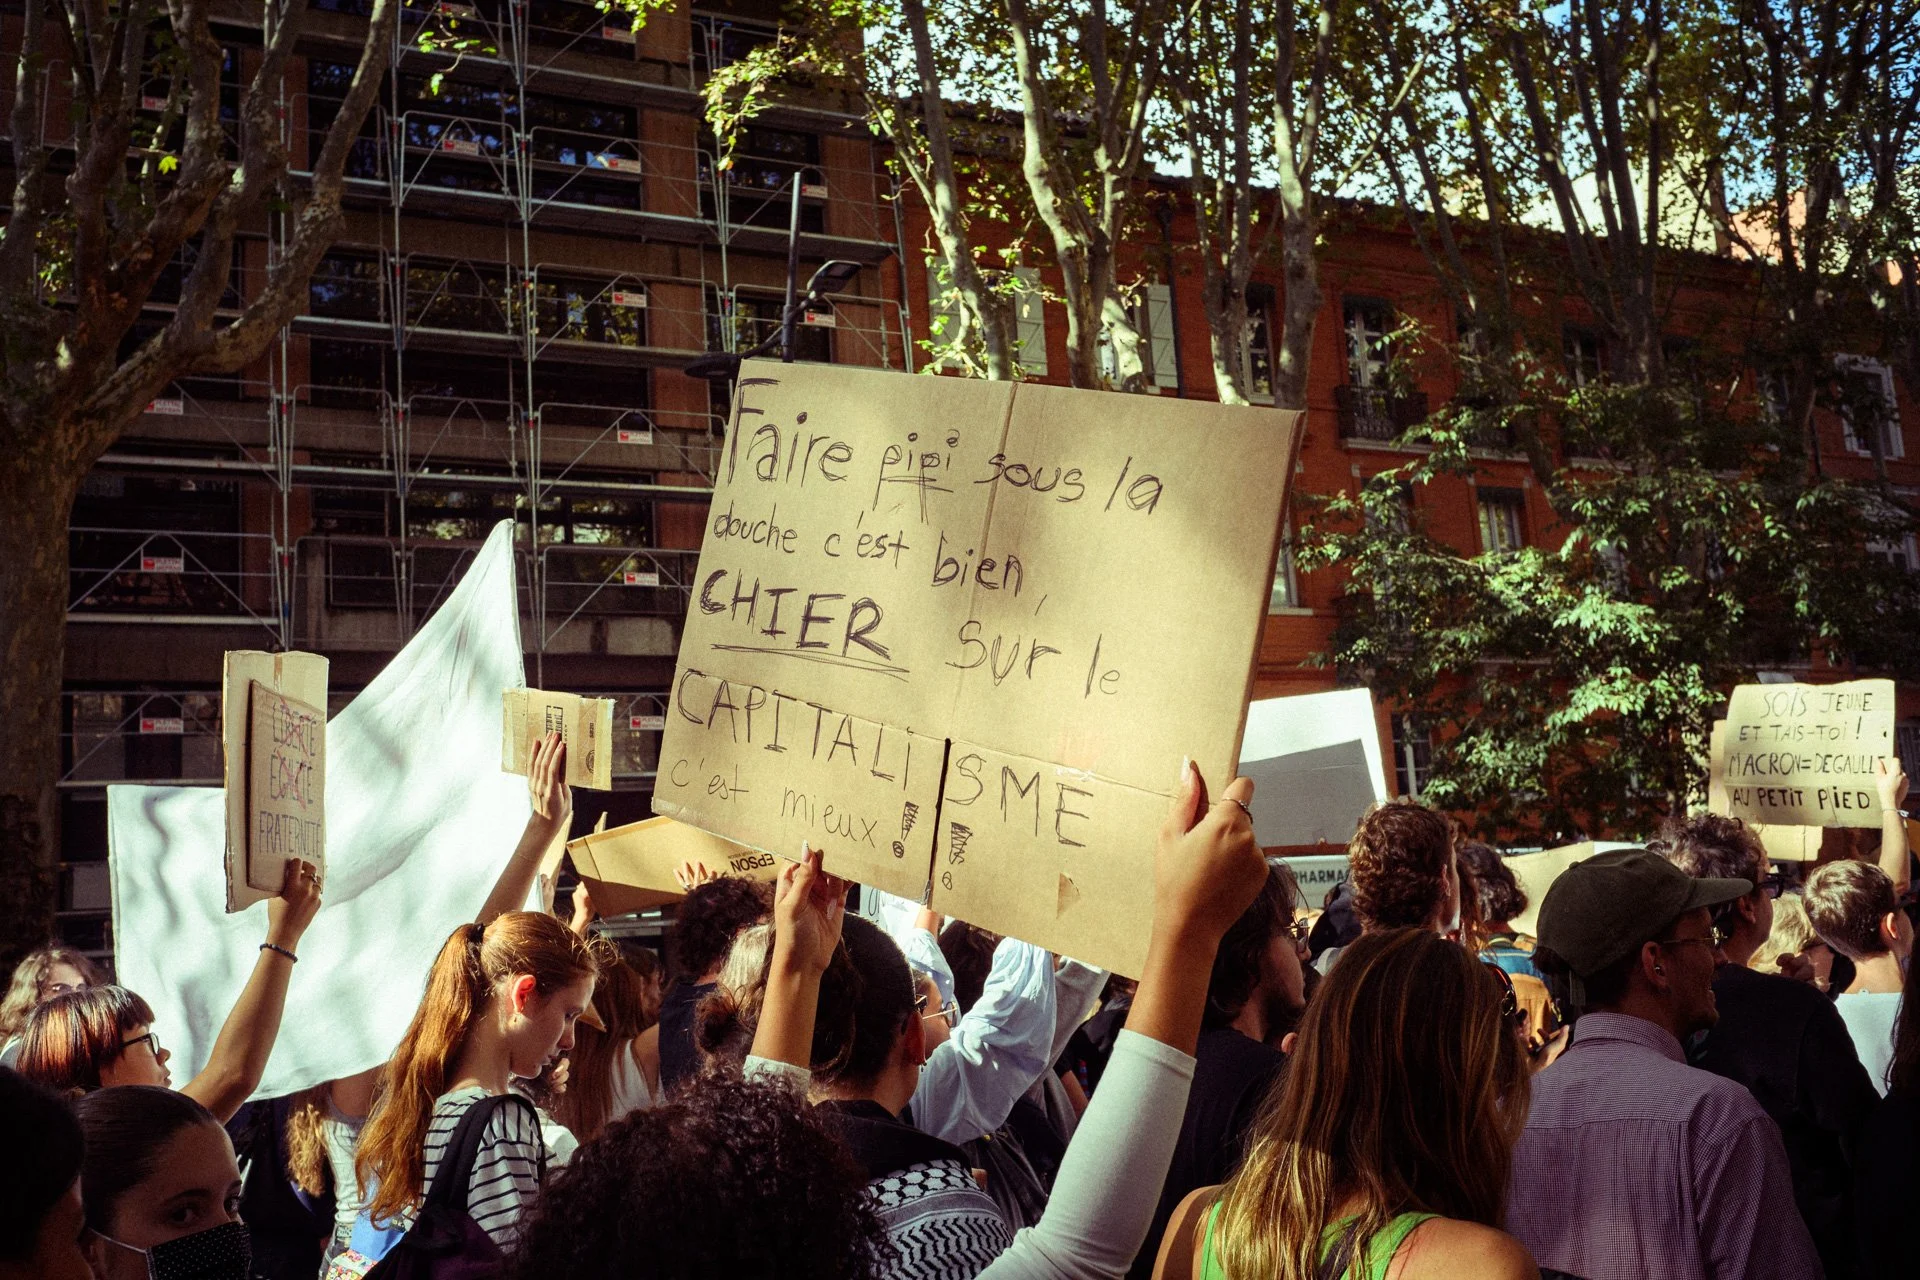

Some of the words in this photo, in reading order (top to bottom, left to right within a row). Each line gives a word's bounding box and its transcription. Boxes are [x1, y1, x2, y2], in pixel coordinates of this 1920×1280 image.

[728, 377, 853, 487] Faire
[872, 429, 960, 525] pipi
[974, 453, 1085, 502] sous
[1104, 456, 1163, 515] la
[714, 500, 798, 554] douche
[824, 510, 909, 569] c'est
[700, 568, 892, 660] CHIER
[1085, 633, 1120, 699] le
[1819, 692, 1873, 713] JEUNE
[1739, 725, 1761, 741] ET
[1733, 788, 1750, 806] AU
[259, 810, 321, 859] FRATERNITÉ
[730, 853, 776, 873] EPSON
